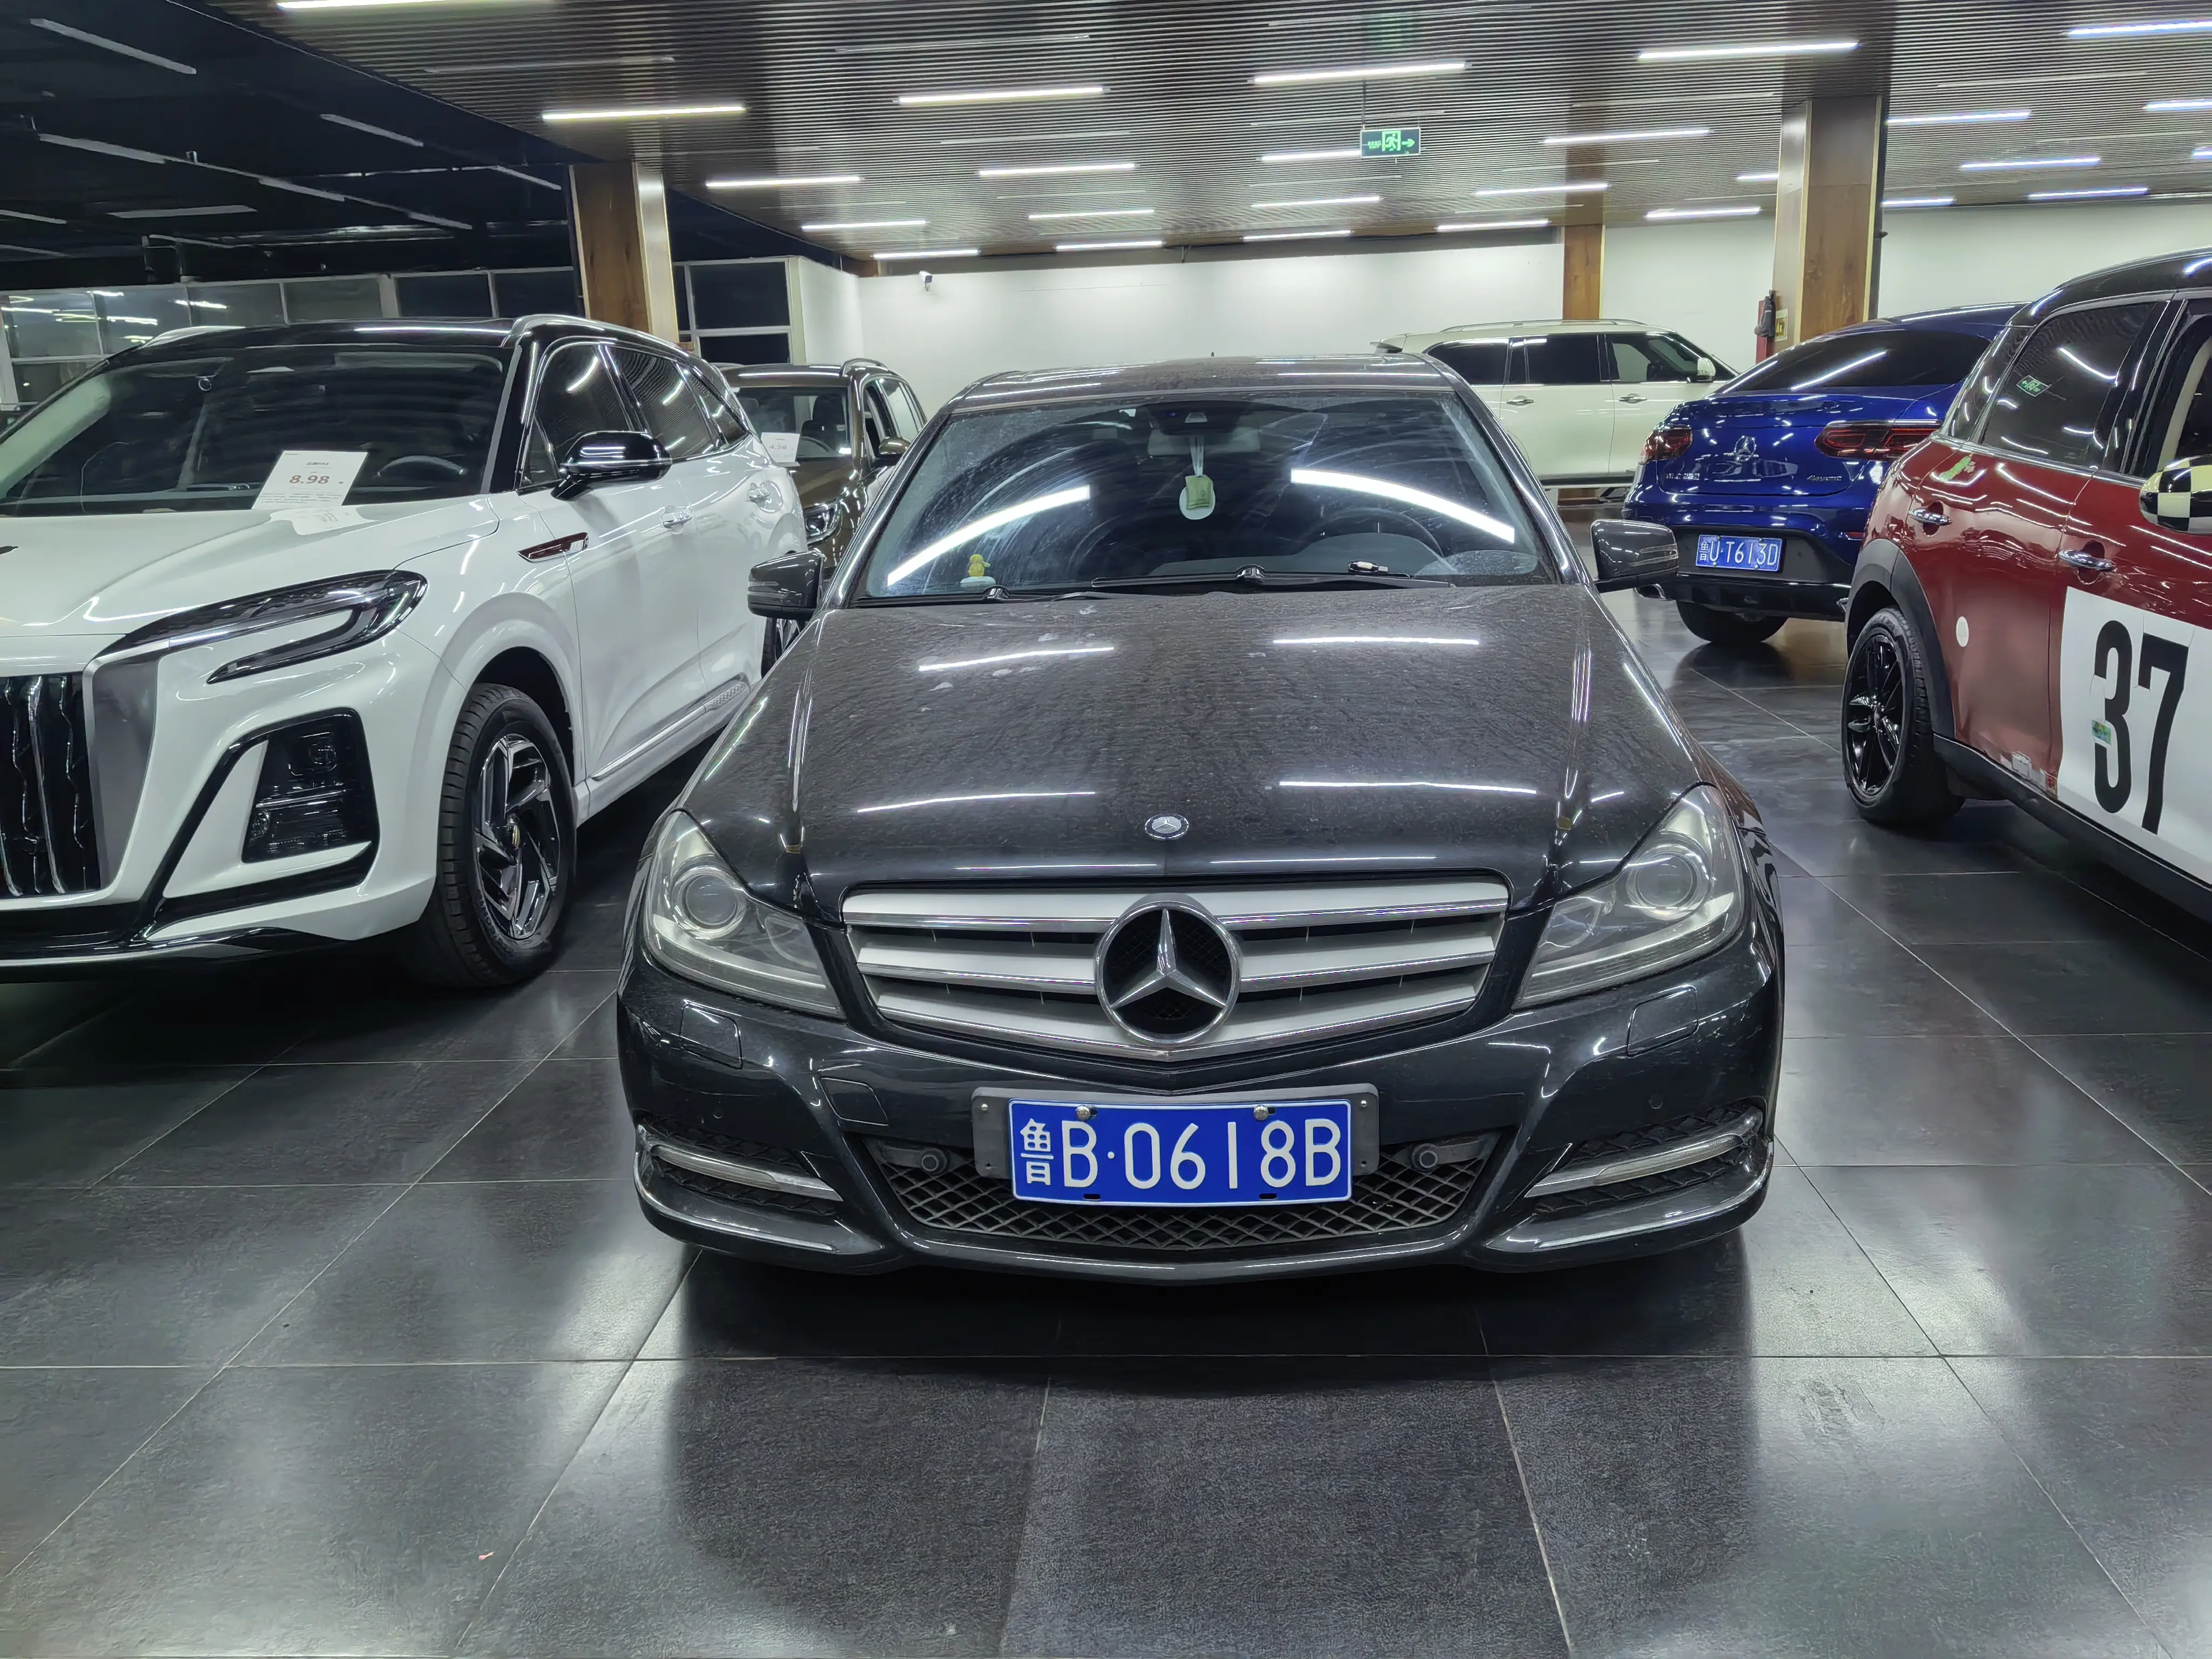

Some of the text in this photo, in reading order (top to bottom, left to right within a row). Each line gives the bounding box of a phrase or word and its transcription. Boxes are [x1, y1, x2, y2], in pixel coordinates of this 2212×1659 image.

[289, 475, 329, 484] 8.98
[2094, 619, 2189, 835] 37
[1020, 1118, 1340, 1190] 鲁B·0618B
